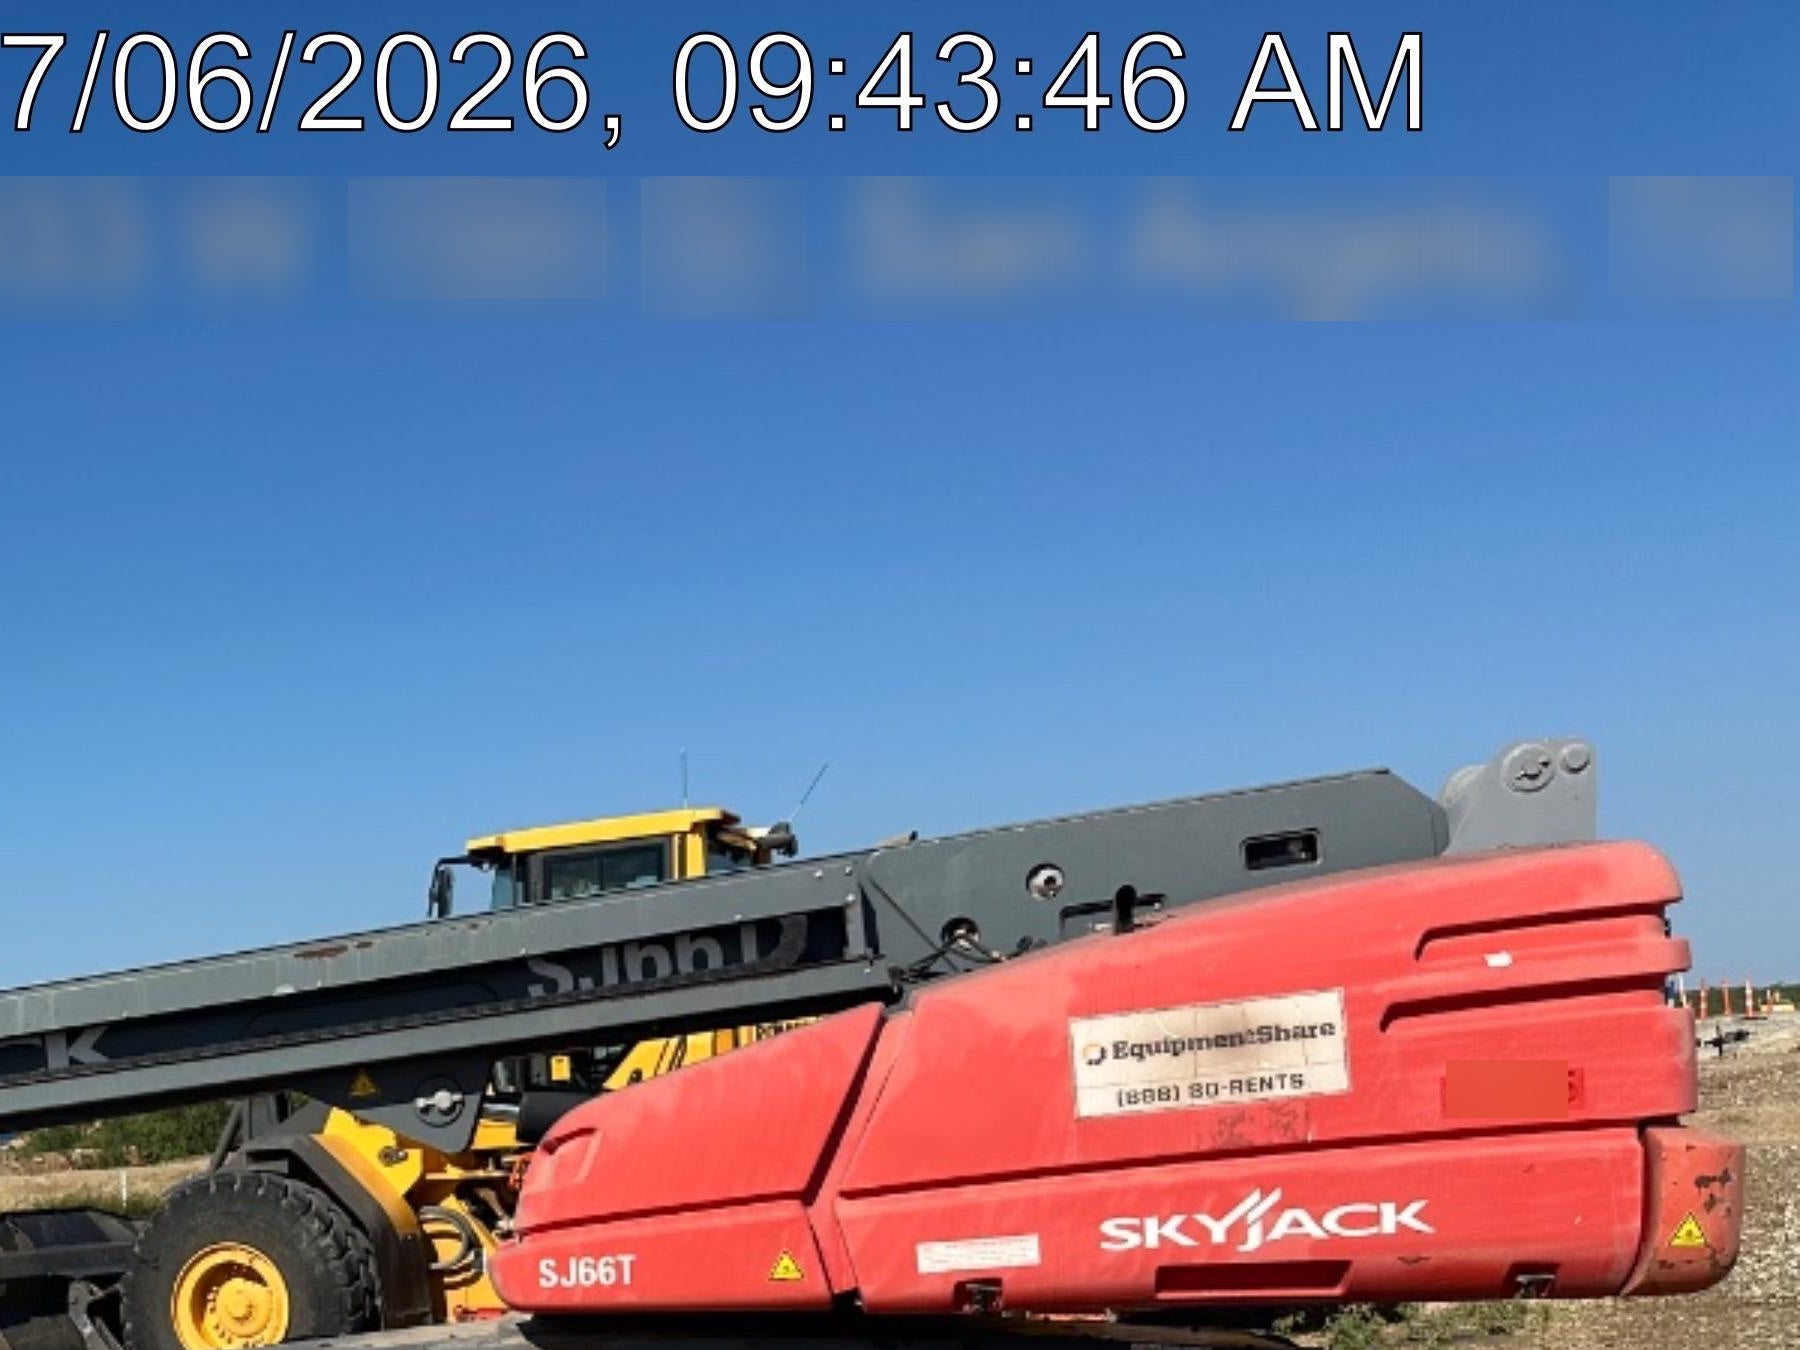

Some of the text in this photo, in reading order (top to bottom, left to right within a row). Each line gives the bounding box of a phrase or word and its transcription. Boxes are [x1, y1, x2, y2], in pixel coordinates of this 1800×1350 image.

[1112, 1021, 1336, 1063] EquipmentShare
[1188, 1072, 1305, 1099] 80-RENTS
[1098, 1187, 1436, 1253] SKYJACK
[539, 1253, 637, 1289] SJ66T
